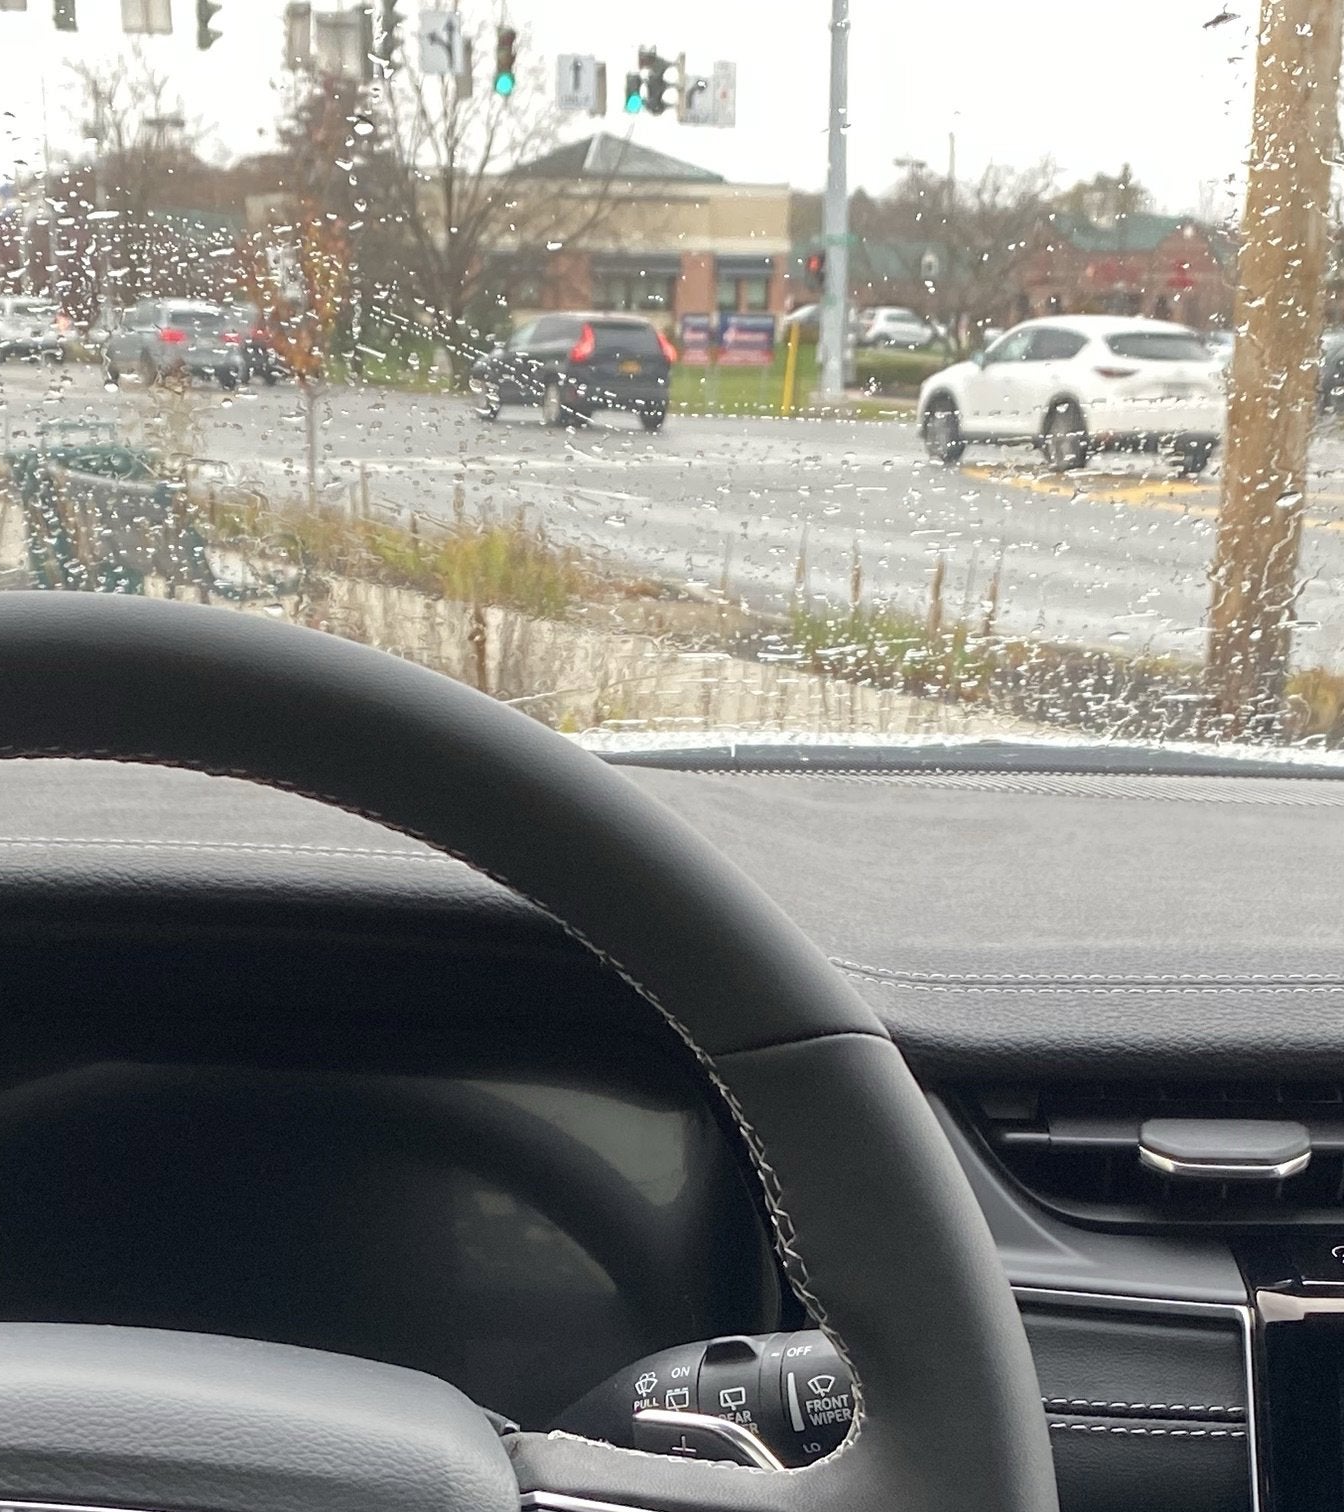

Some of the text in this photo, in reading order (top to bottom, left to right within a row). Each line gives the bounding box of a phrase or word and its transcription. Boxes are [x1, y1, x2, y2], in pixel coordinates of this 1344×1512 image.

[786, 1345, 813, 1358] OFF
[671, 1366, 691, 1379] ON
[633, 1397, 659, 1411] PULL
[805, 1394, 850, 1414] FRONT
[809, 1408, 852, 1426] WIPER
[803, 1442, 821, 1454] LO
